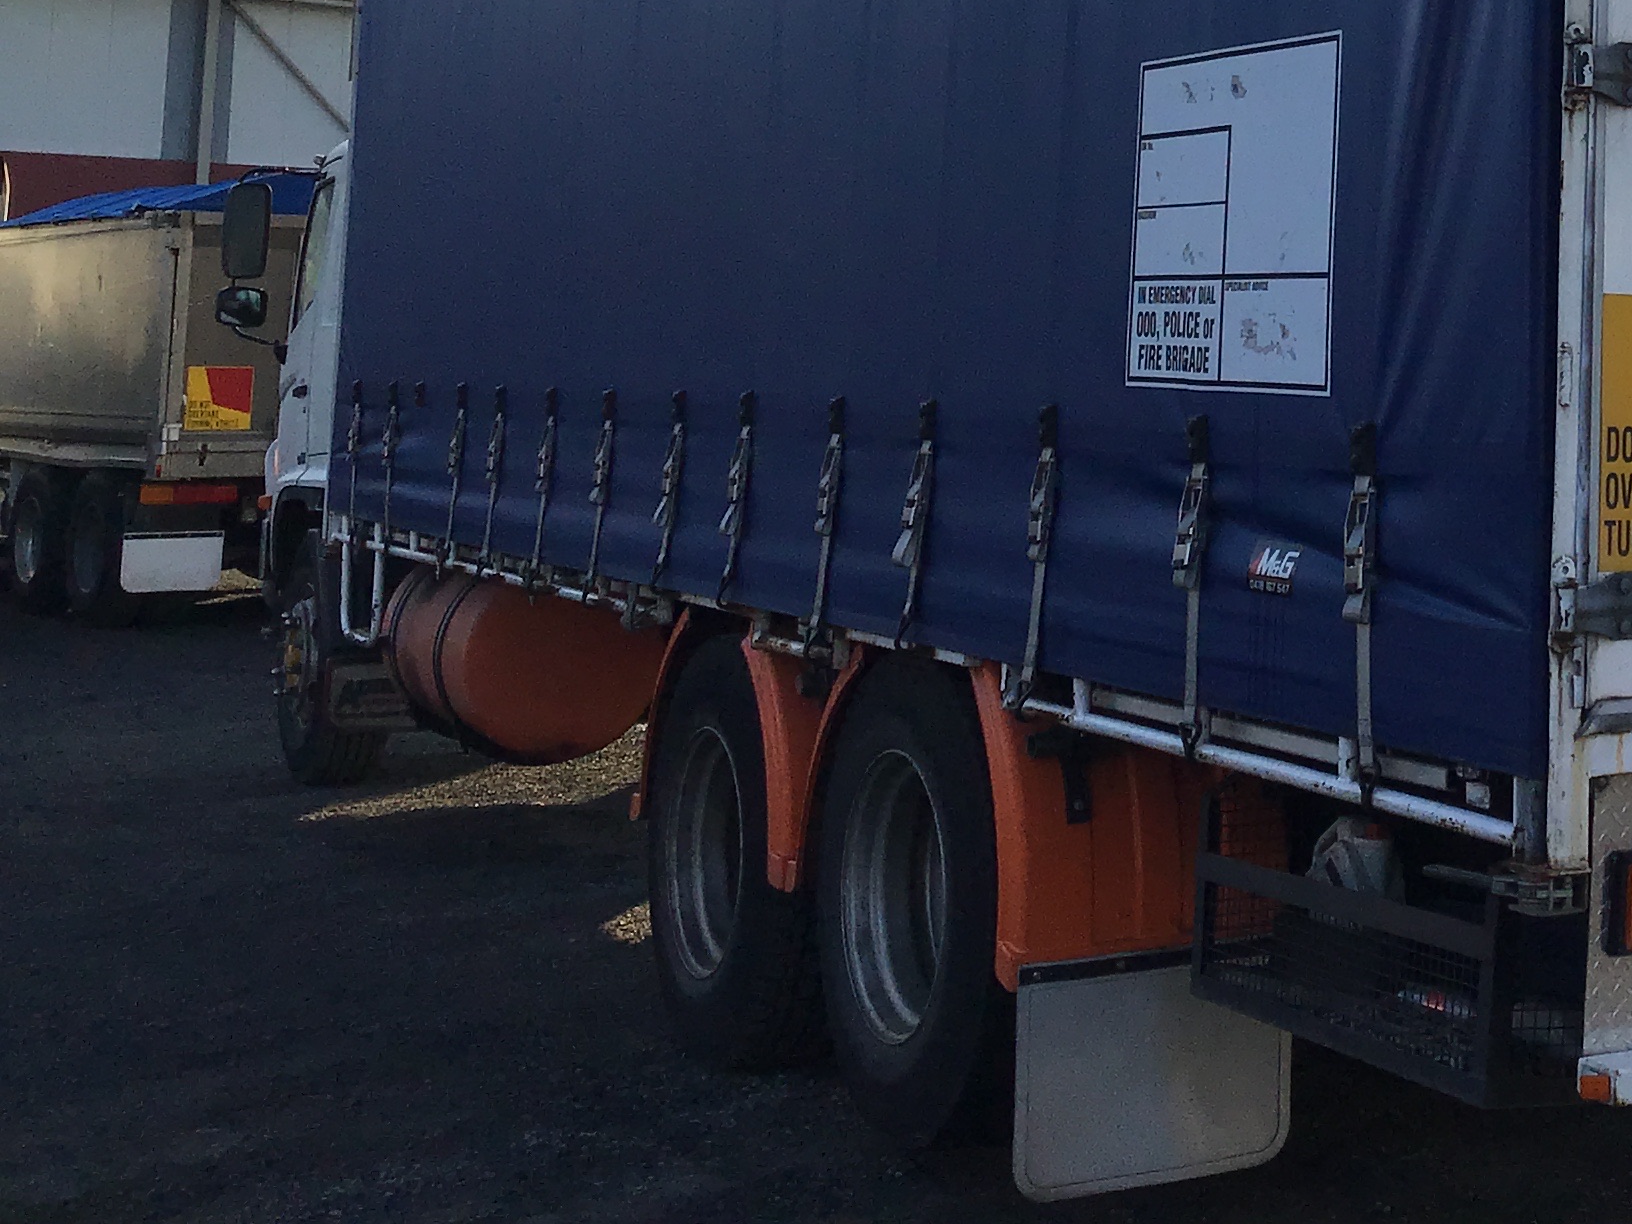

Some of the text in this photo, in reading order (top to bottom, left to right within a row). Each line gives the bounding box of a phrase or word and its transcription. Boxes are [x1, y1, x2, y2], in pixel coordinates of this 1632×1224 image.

[1137, 285, 1216, 305] IN EMERGENCY DIAL
[1163, 310, 1201, 339] POLICE
[1202, 317, 1215, 339] or
[1137, 344, 1210, 374] FIRE BRIGADE
